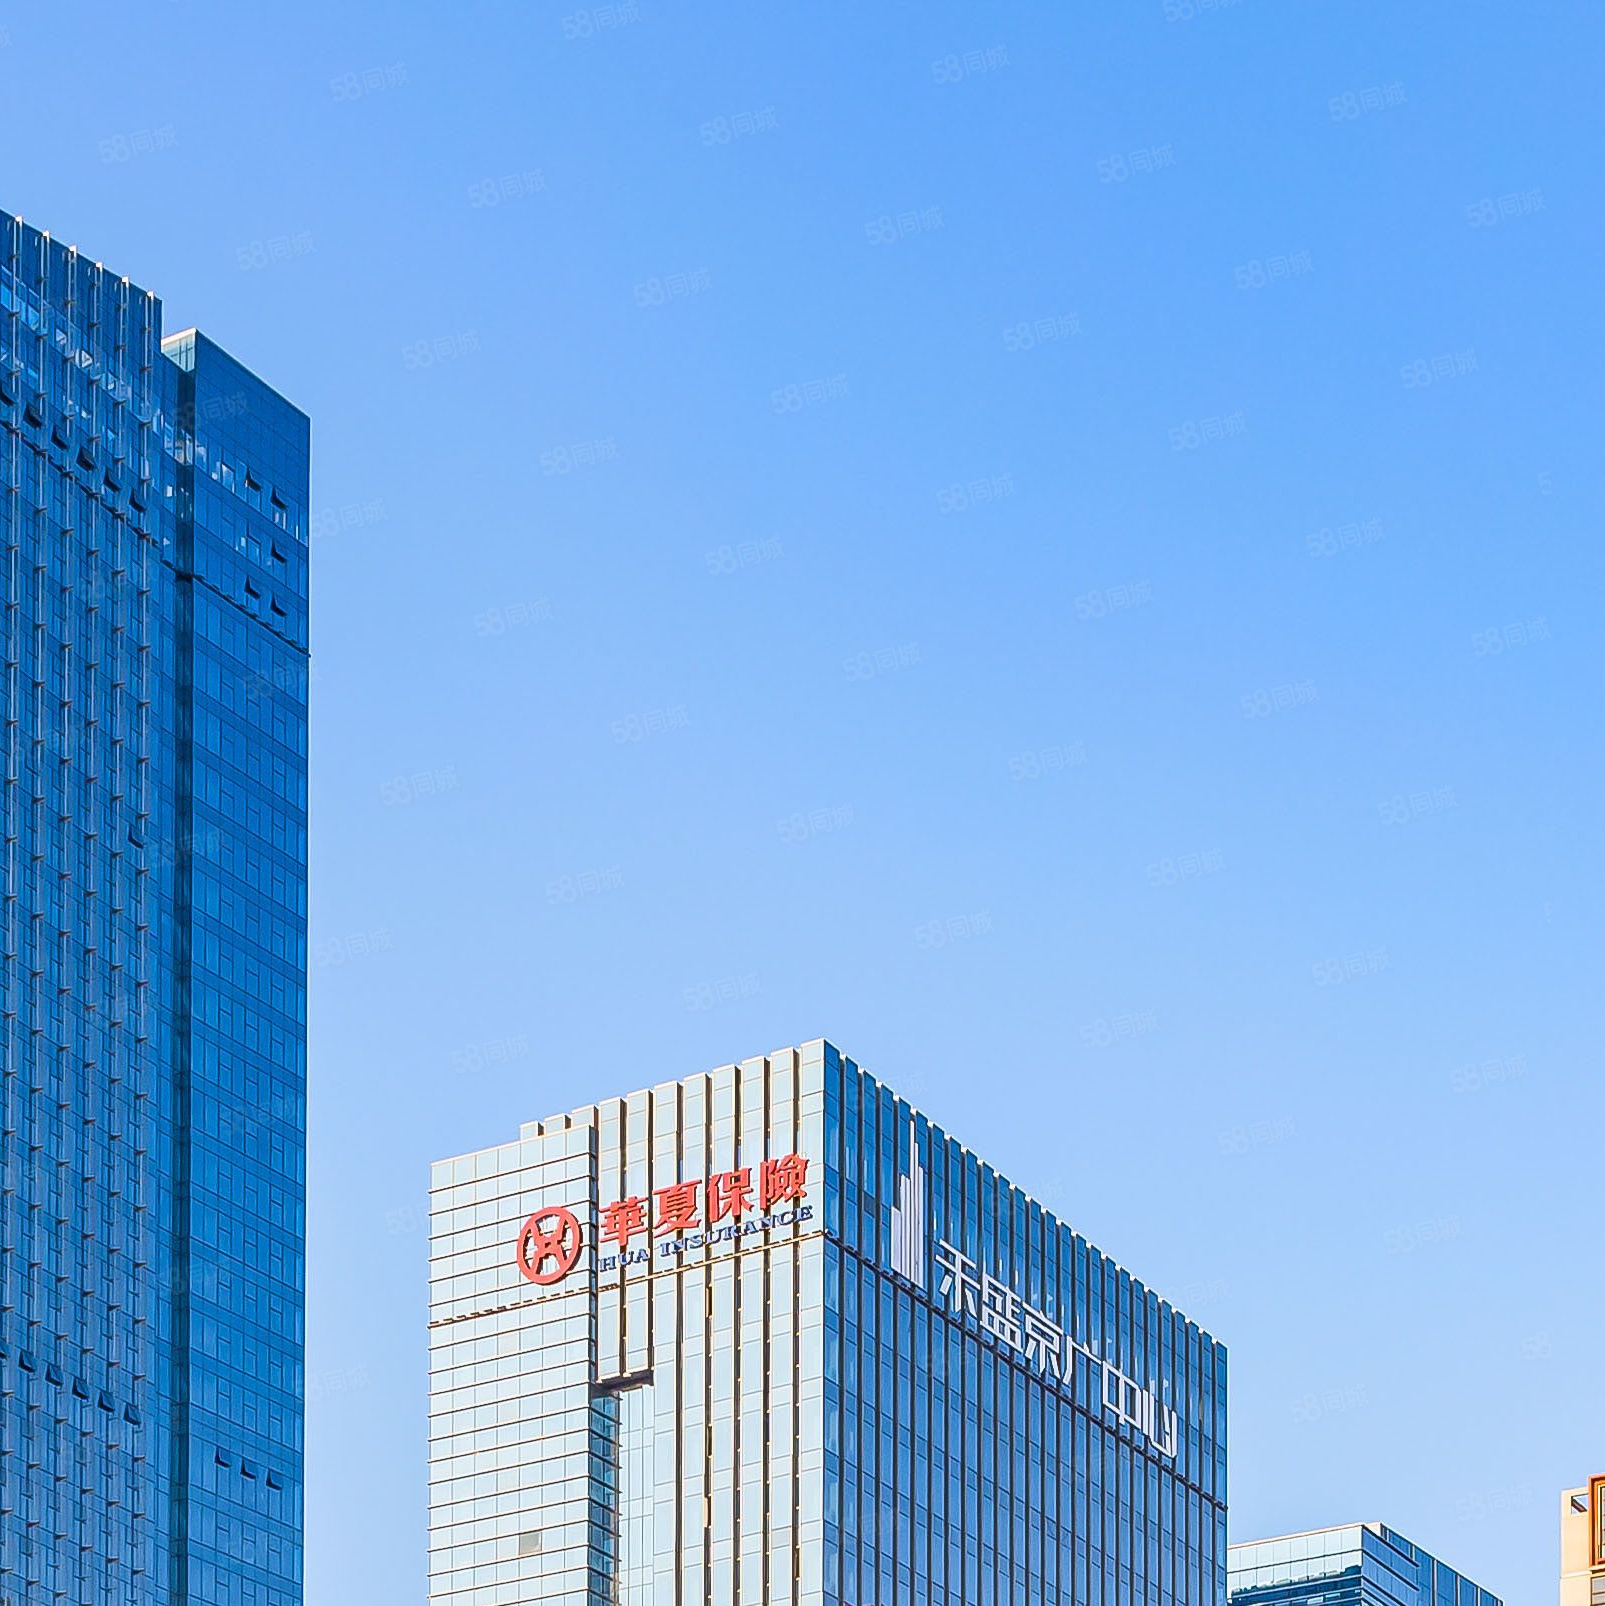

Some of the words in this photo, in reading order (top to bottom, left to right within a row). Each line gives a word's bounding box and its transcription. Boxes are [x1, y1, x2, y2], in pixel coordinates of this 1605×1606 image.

[598, 1152, 810, 1247] 華夏保險
[660, 1204, 814, 1257] INSURANCE
[935, 1238, 1178, 1460] 禾盛京广中心
